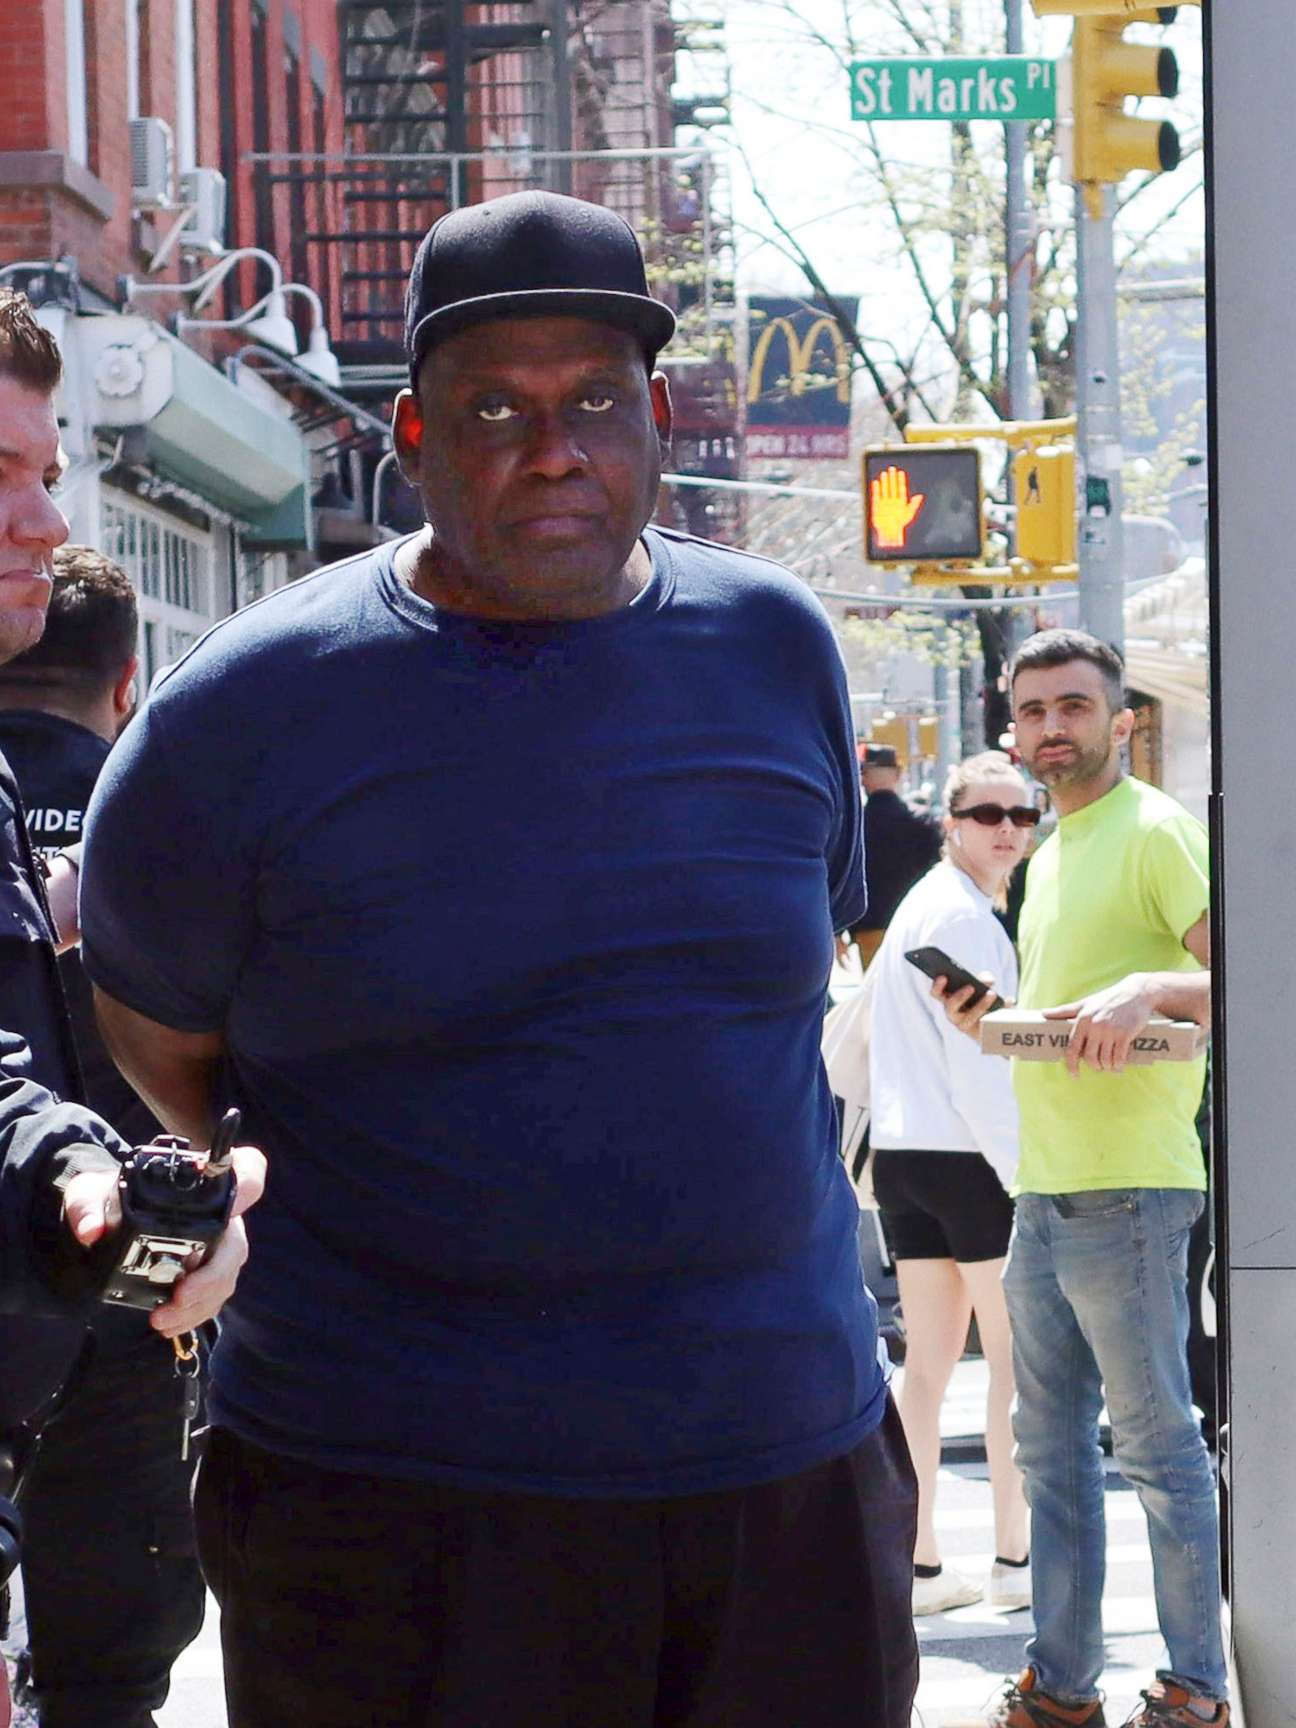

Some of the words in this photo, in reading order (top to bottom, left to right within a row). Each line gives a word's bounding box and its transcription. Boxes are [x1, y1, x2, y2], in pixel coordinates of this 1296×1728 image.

[855, 66, 893, 114] St
[907, 66, 1018, 114] Marks
[1026, 62, 1050, 89] Pl
[24, 808, 85, 832] VIDE
[1001, 1032, 1045, 1047] EAST
[1129, 1037, 1170, 1052] IZZA
